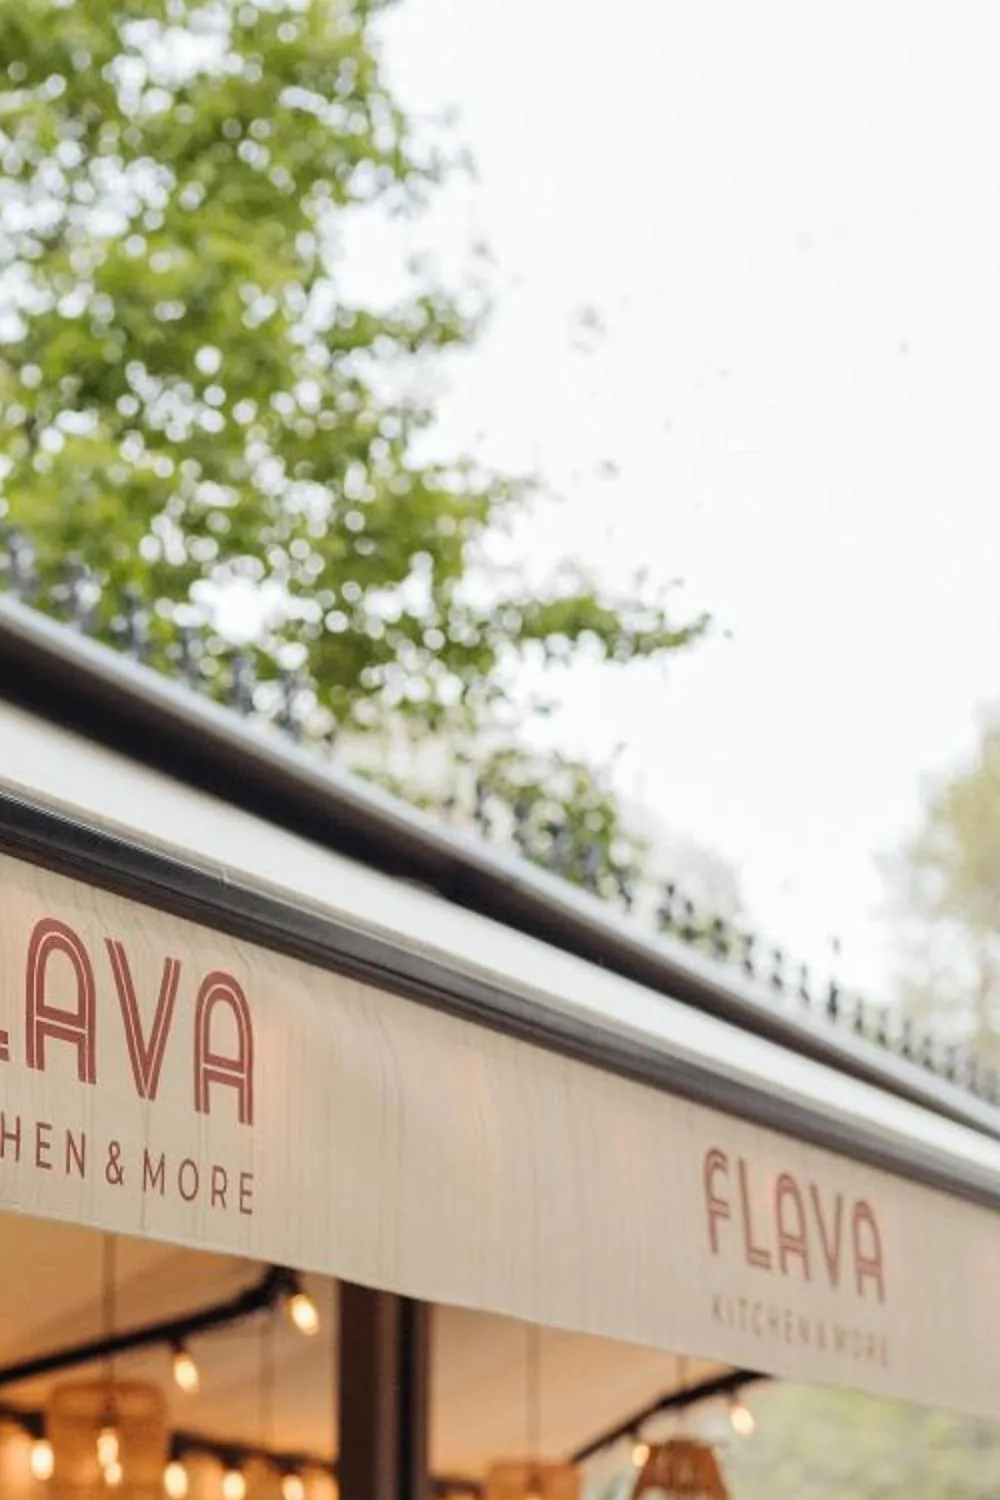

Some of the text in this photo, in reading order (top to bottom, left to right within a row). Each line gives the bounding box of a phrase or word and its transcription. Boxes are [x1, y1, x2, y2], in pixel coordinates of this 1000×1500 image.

[105, 1140, 125, 1186] &
[142, 1148, 255, 1216] MORE
[703, 1147, 886, 1306] FLAVA
